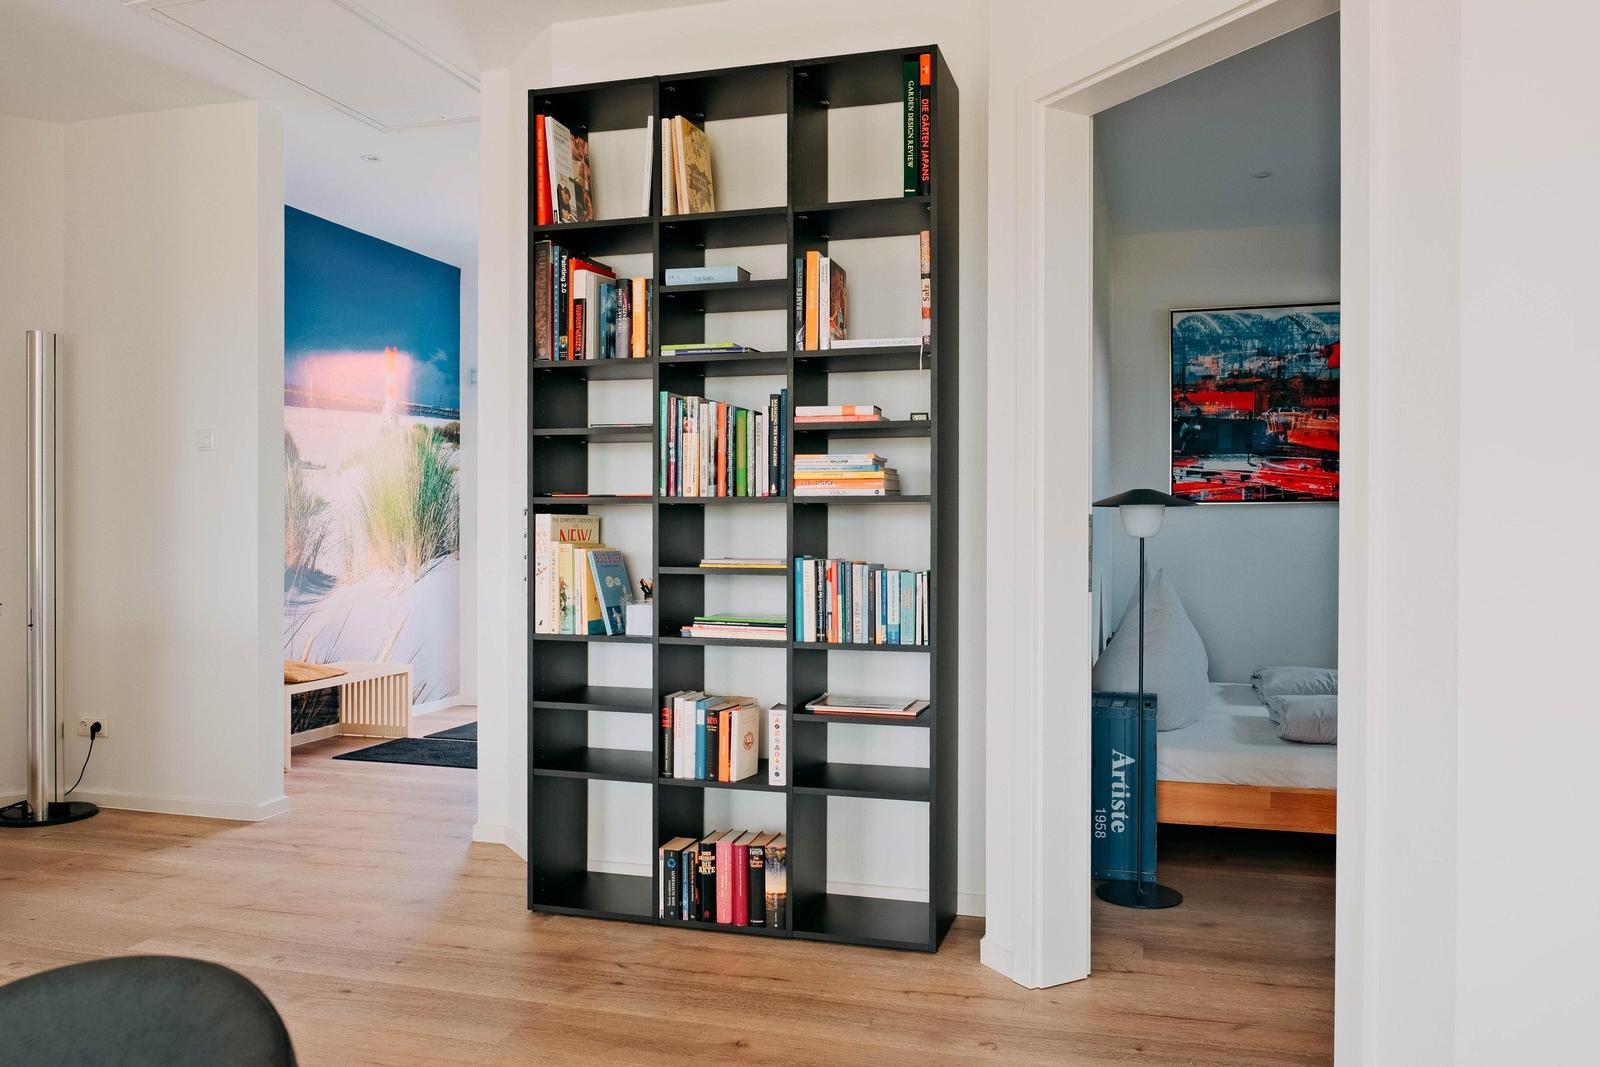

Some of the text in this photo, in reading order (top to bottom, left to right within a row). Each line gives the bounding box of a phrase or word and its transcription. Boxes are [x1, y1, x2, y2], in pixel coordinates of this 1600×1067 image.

[907, 80, 915, 168] GARDEN DESIGN REVIEW
[921, 98, 931, 182] DIE GÄRTEN JAPANS
[560, 255, 568, 295] Painting 2.0
[922, 284, 931, 302] Salz
[1111, 749, 1136, 833] Artiste
[1094, 807, 1107, 840] 1958
